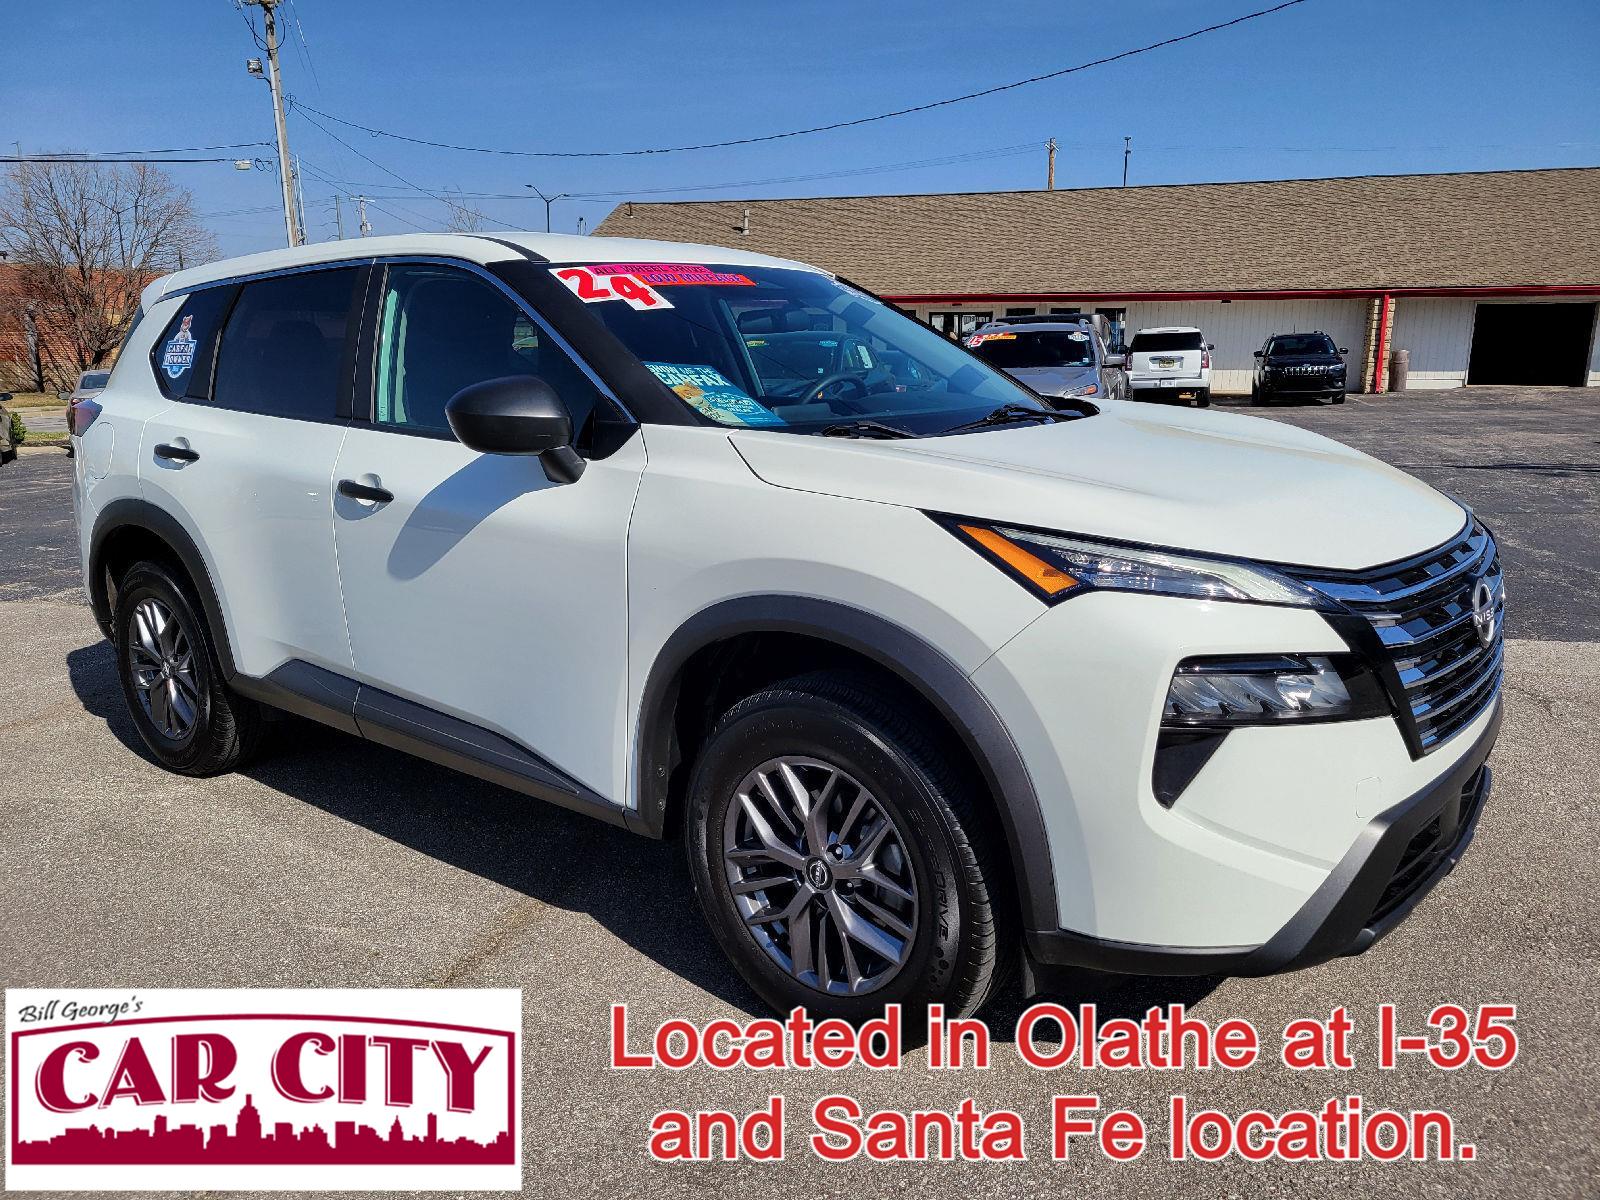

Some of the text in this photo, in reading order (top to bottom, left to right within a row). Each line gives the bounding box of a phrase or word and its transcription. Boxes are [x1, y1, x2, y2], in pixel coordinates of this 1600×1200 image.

[595, 265, 706, 275] ALL WHEEL DRIVE
[641, 273, 744, 283] LOW MILEAGE
[556, 268, 658, 307] 24
[645, 365, 716, 376] SHOW ME THE
[653, 371, 732, 387] CARFAX
